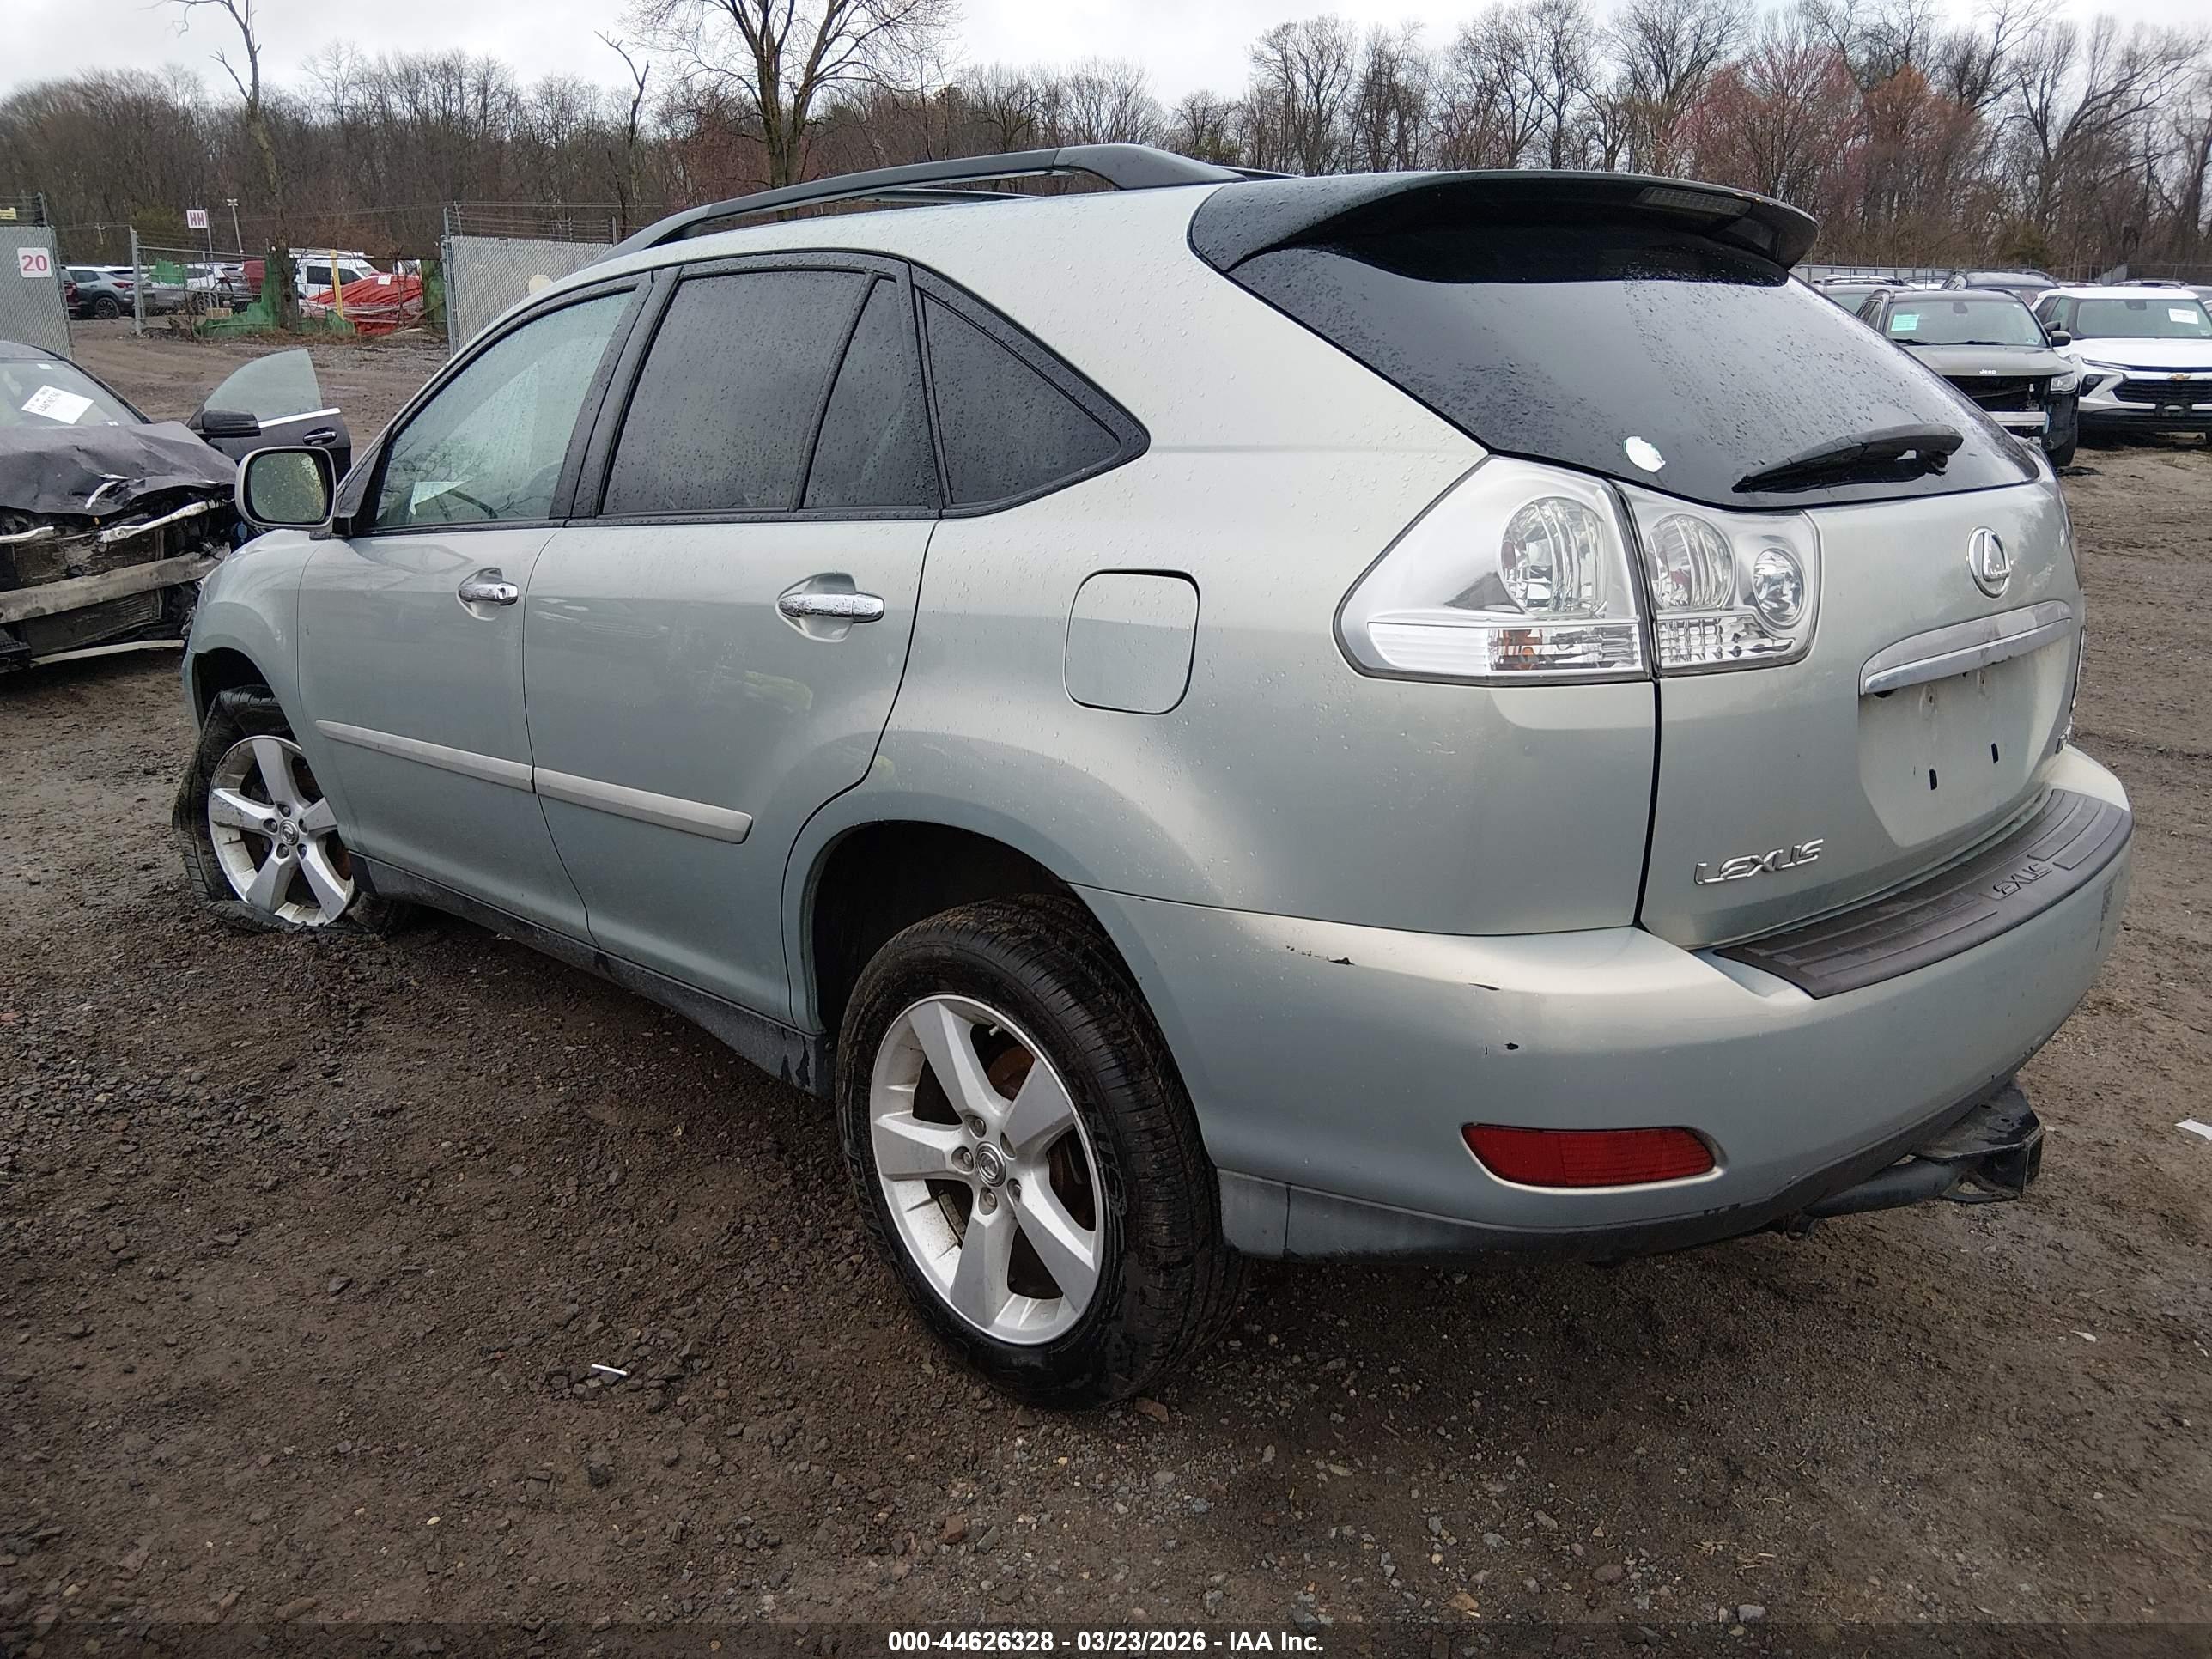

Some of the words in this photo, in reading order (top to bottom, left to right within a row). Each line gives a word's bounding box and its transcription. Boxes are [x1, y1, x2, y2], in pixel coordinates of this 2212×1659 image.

[189, 212, 205, 226] HH
[21, 254, 48, 272] 20
[1694, 837, 1825, 885] LEXUS
